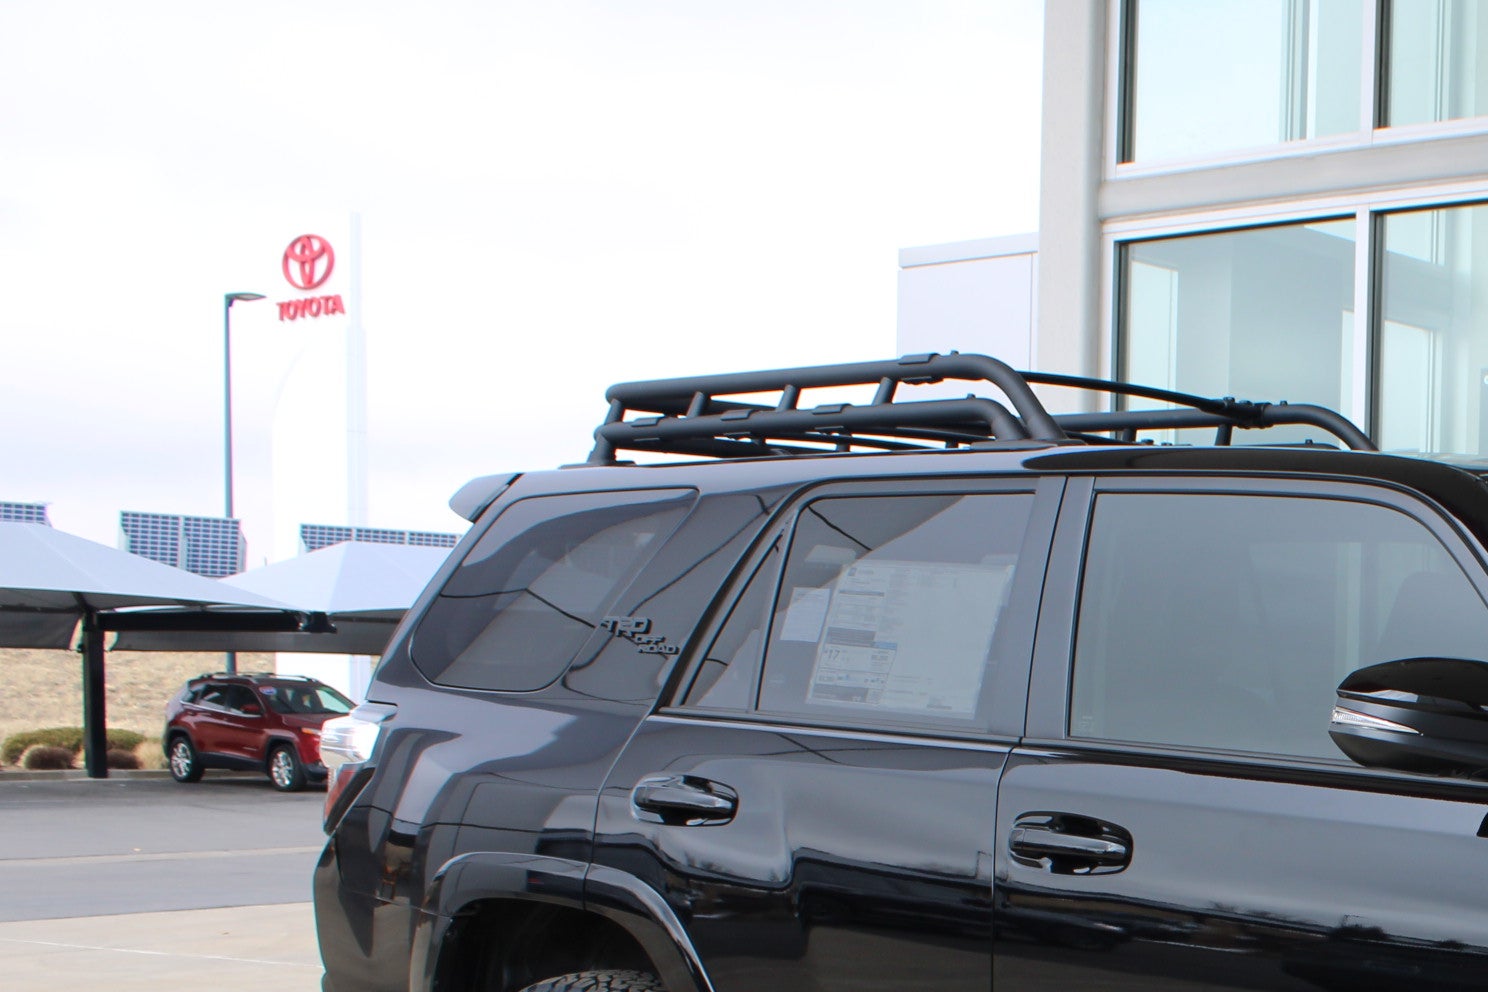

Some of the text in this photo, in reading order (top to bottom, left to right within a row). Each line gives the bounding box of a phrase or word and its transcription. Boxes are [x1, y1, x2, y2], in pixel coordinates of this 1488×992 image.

[276, 294, 346, 322] TOYOTA
[600, 615, 653, 637] TRD
[635, 635, 667, 645] OFF
[637, 645, 680, 655] ROAD
